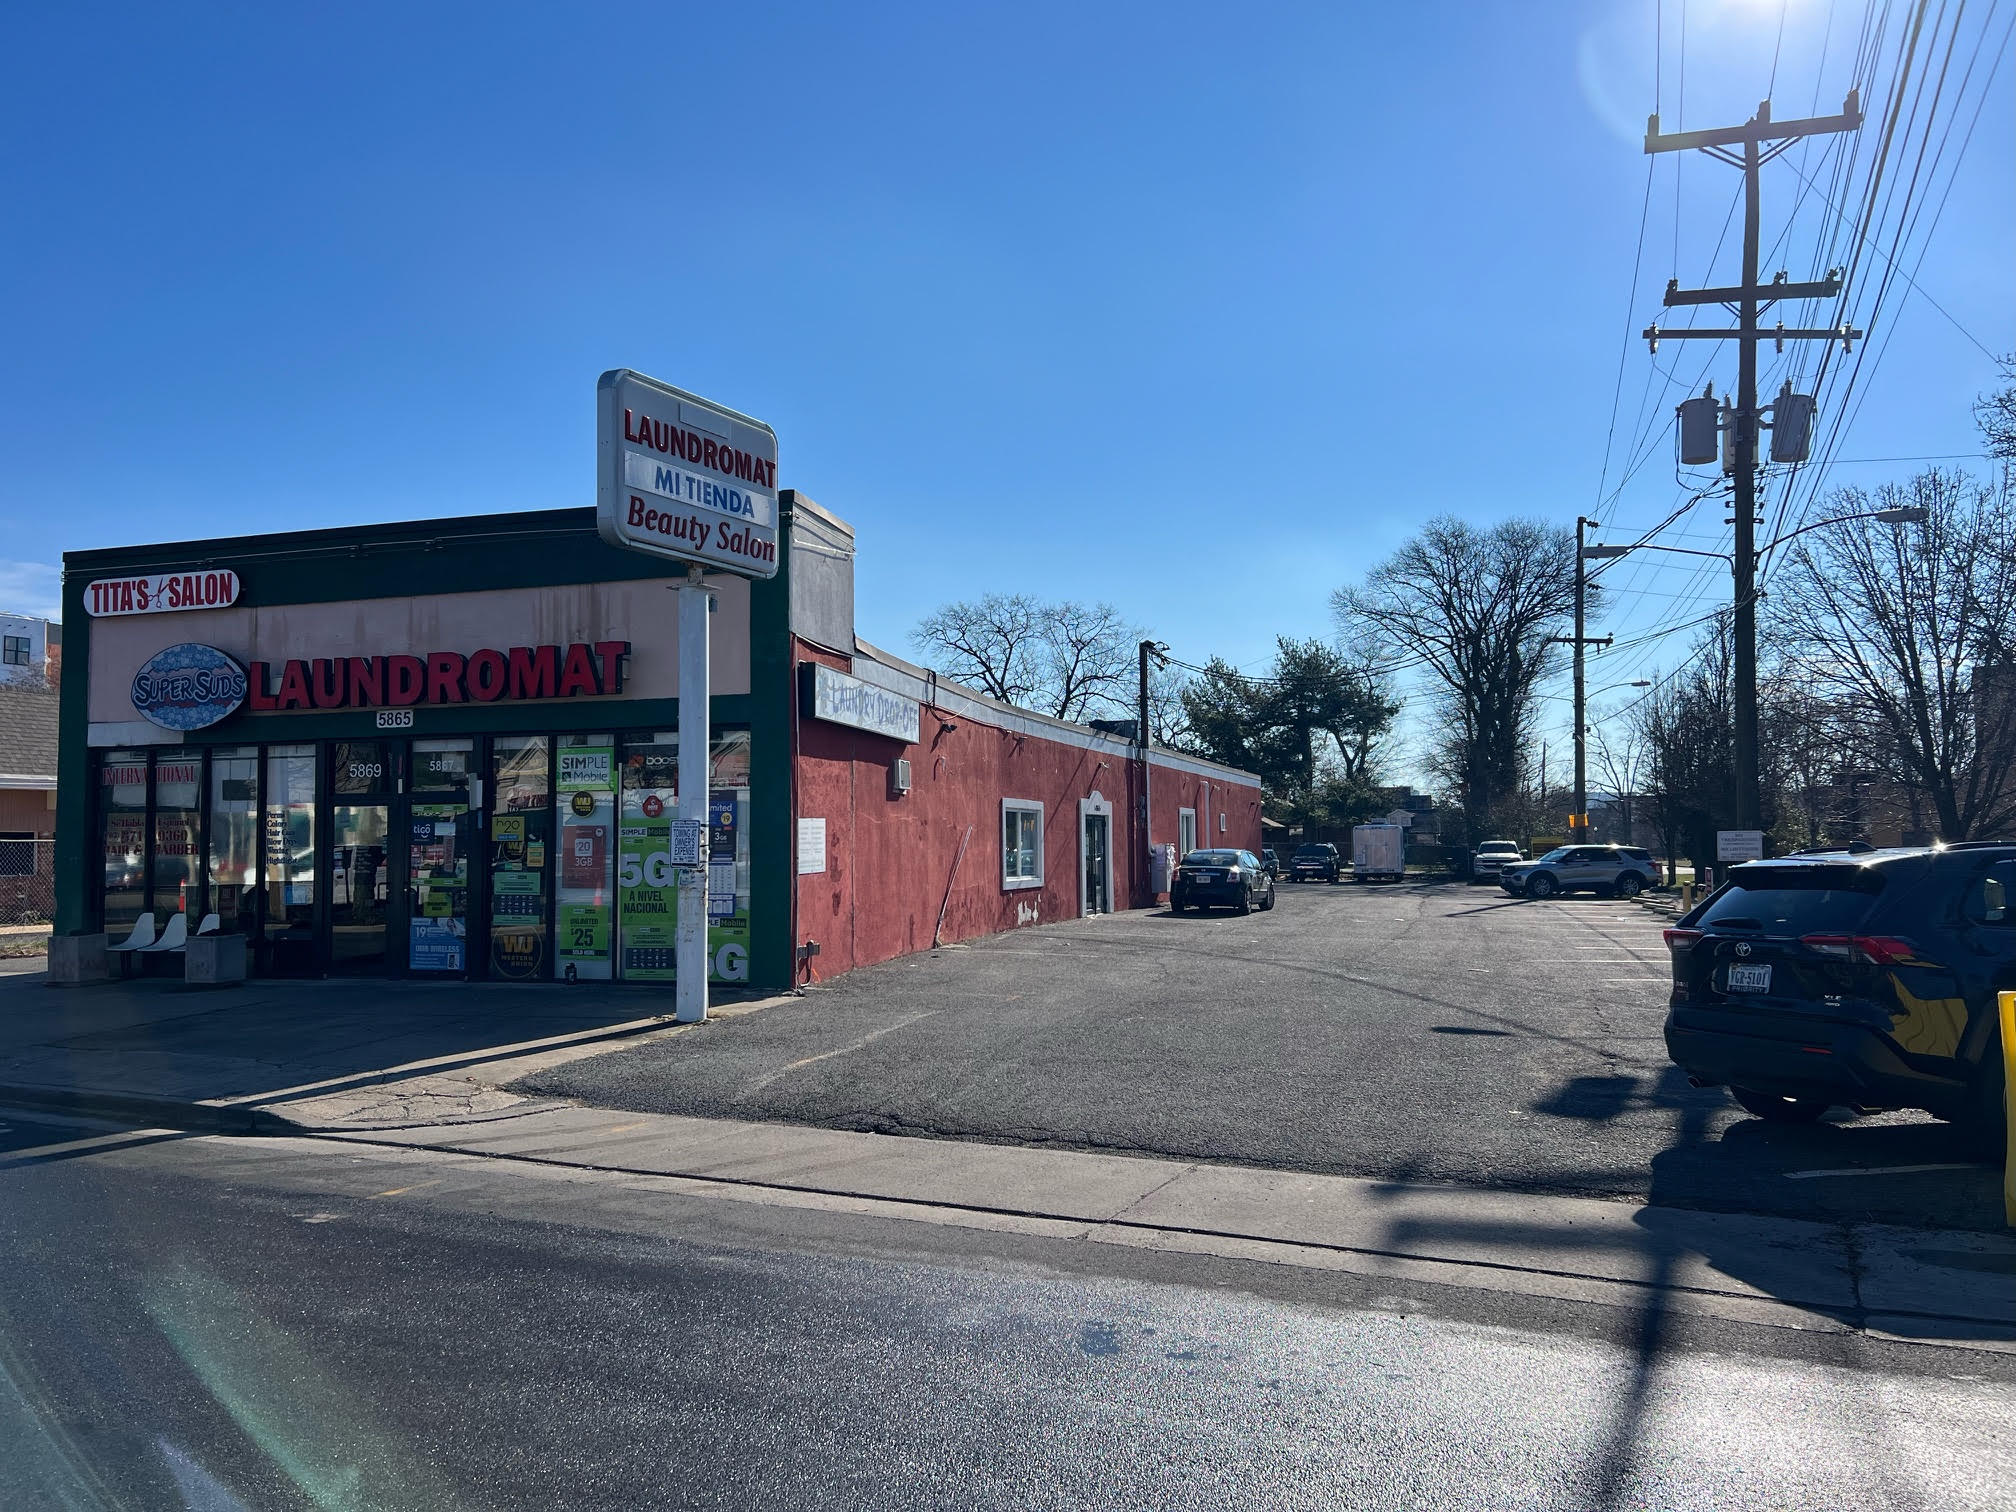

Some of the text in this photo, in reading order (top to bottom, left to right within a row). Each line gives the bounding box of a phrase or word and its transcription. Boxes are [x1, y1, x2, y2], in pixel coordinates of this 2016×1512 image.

[625, 408, 775, 488] LAUNDROMAT
[654, 466, 755, 518] MI TIENDA
[627, 495, 775, 562] Beauty Salon
[91, 572, 232, 613] TITA'S SALON
[250, 641, 630, 711] LAUNDROMAT
[134, 669, 246, 705] SUPER SUDS
[378, 711, 410, 726] 5865
[349, 763, 382, 777] 5869
[429, 760, 454, 771] 5867
[562, 756, 607, 769] SIMPLE
[574, 771, 608, 782] Mobile
[575, 857, 592, 866] 3GB
[620, 851, 674, 888] 5G
[629, 891, 664, 901] A NIVEL
[624, 903, 669, 913] NACIONAL
[570, 928, 593, 946] $25
